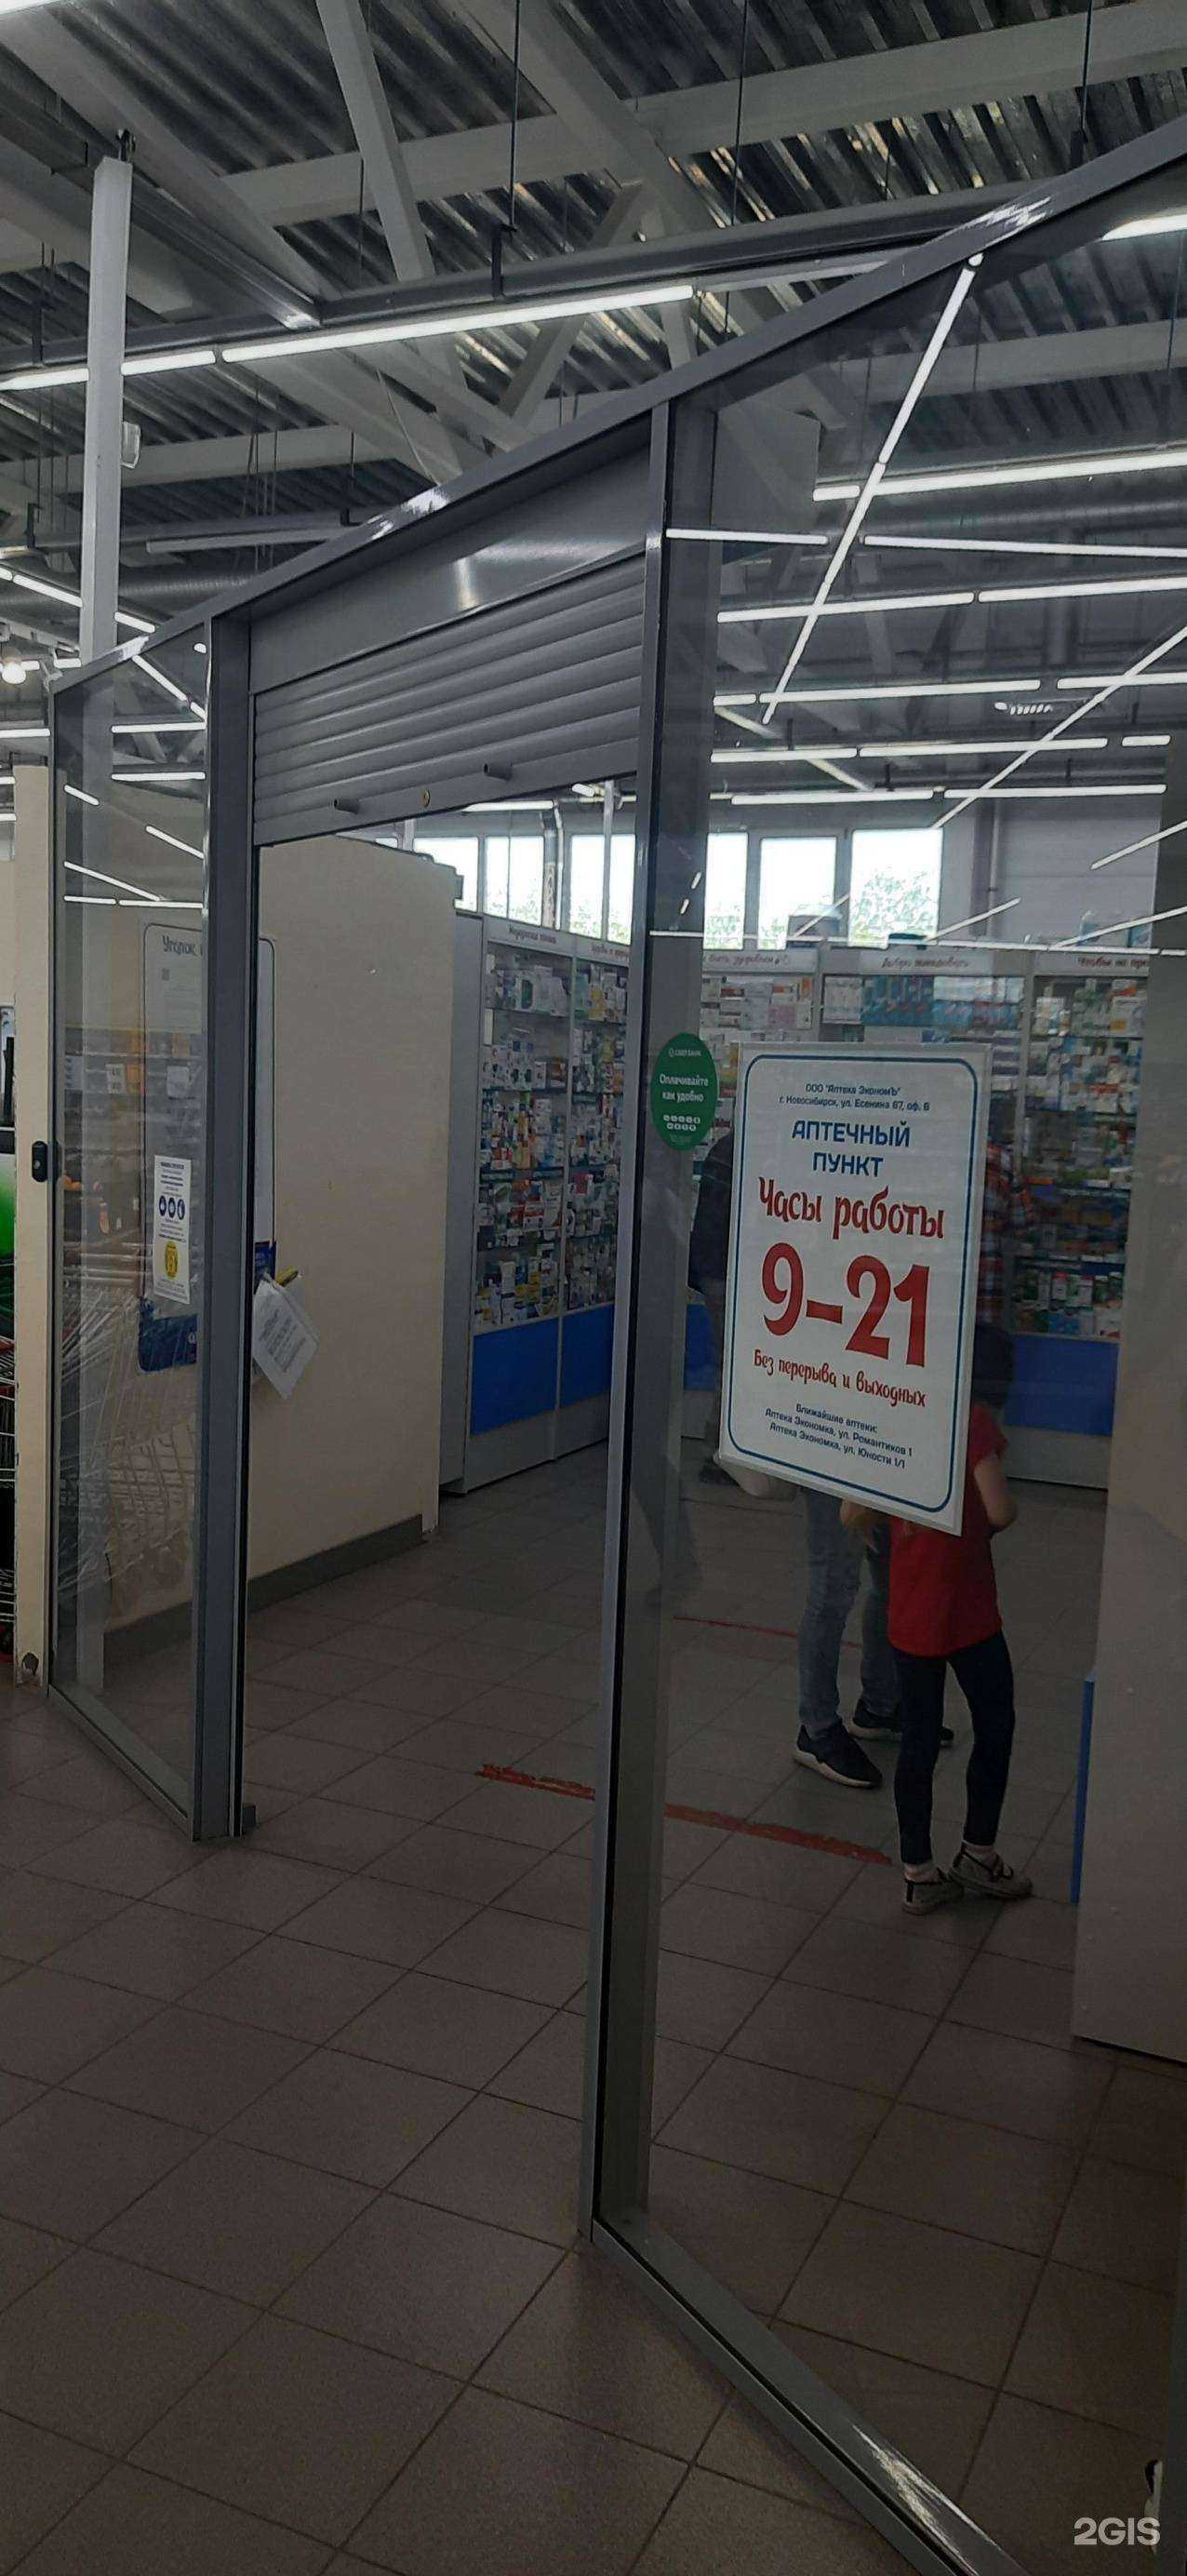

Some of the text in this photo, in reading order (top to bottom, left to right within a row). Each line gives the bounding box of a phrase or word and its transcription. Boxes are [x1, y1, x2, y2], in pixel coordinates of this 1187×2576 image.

[806, 1083, 823, 1093] ООО
[786, 1095, 838, 1108] Новосибирск,
[840, 1099, 853, 1110] ул.
[855, 1099, 890, 1109] Есенина
[791, 1120, 910, 1147] АПТЕЧНЫЙ
[812, 1152, 884, 1177] ПУНКТ
[758, 1176, 944, 1240] Часы работы
[754, 1348, 927, 1408] Без перерыва и выходных
[795, 1402, 844, 1425] Ближайшие
[765, 1407, 793, 1423] Аптека
[794, 1415, 836, 1437] Экономка,
[838, 1429, 850, 1441] ул.
[852, 1431, 907, 1456] Романтиков
[769, 1422, 797, 1438] Аптека
[858, 1447, 892, 1465] Юности
